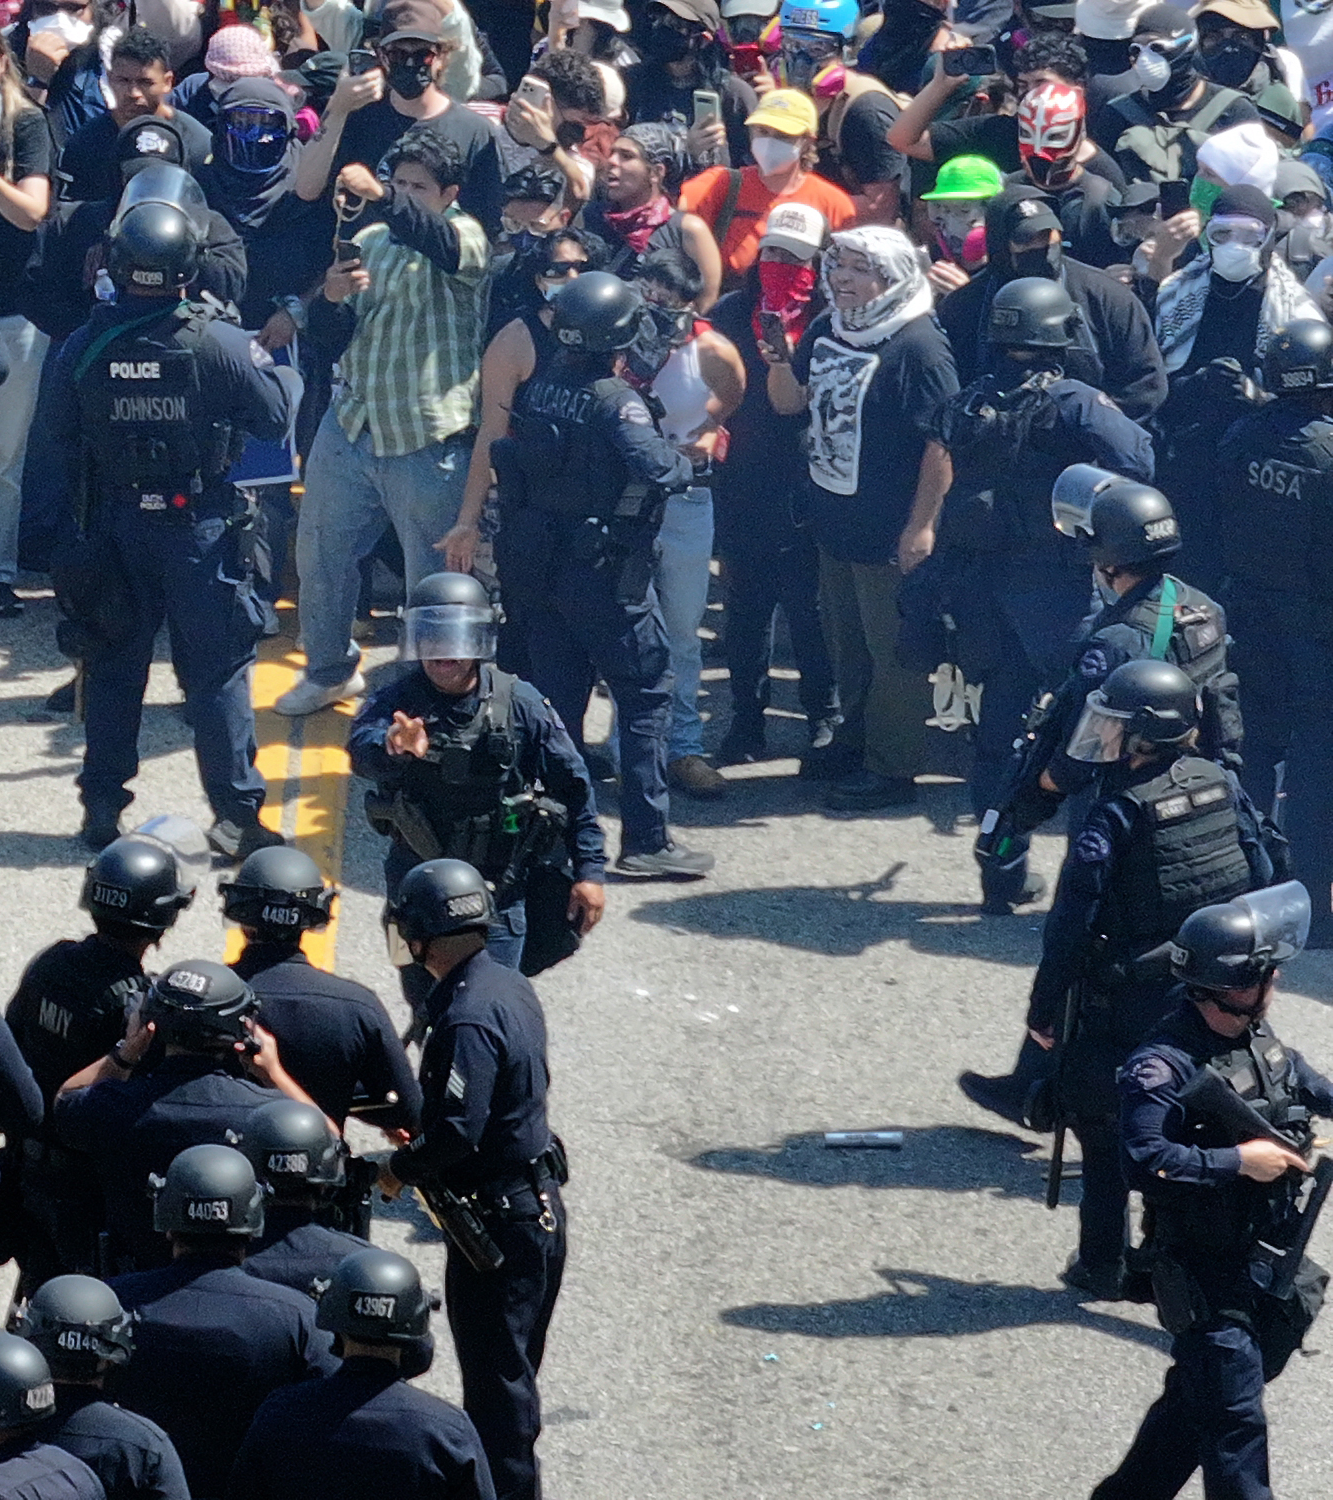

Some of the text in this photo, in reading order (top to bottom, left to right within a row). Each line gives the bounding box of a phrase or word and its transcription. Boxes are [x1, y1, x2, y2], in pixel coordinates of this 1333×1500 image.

[109, 361, 161, 380] POLICE
[109, 396, 187, 422] JOHNSON
[1247, 460, 1302, 502] SOSA
